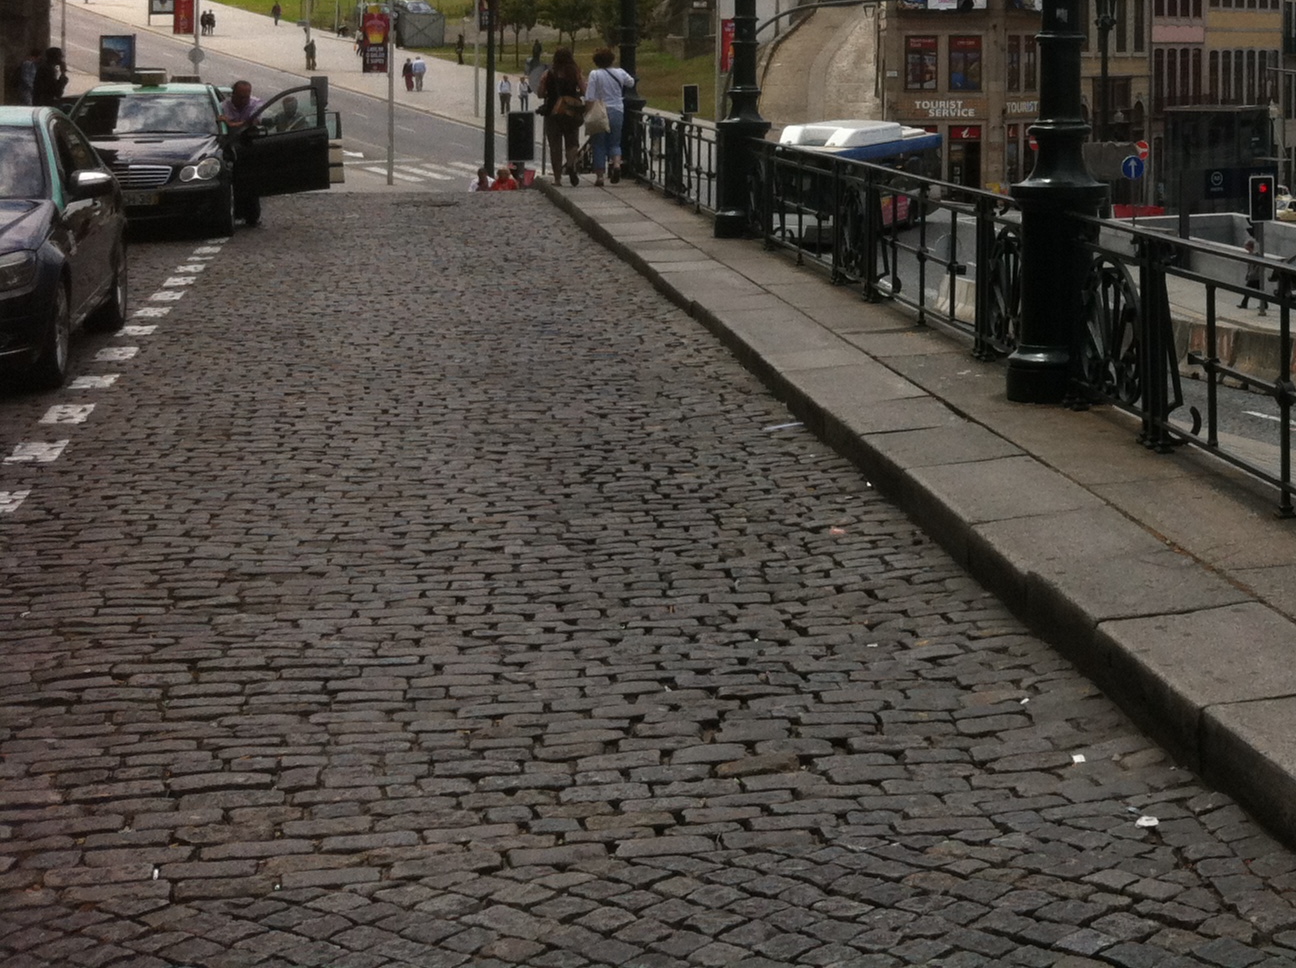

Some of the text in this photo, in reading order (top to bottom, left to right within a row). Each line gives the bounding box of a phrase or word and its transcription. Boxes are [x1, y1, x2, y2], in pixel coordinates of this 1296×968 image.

[915, 100, 963, 110] TOURIST
[1006, 101, 1039, 114] TOURIST
[929, 108, 975, 118] SERVICE
